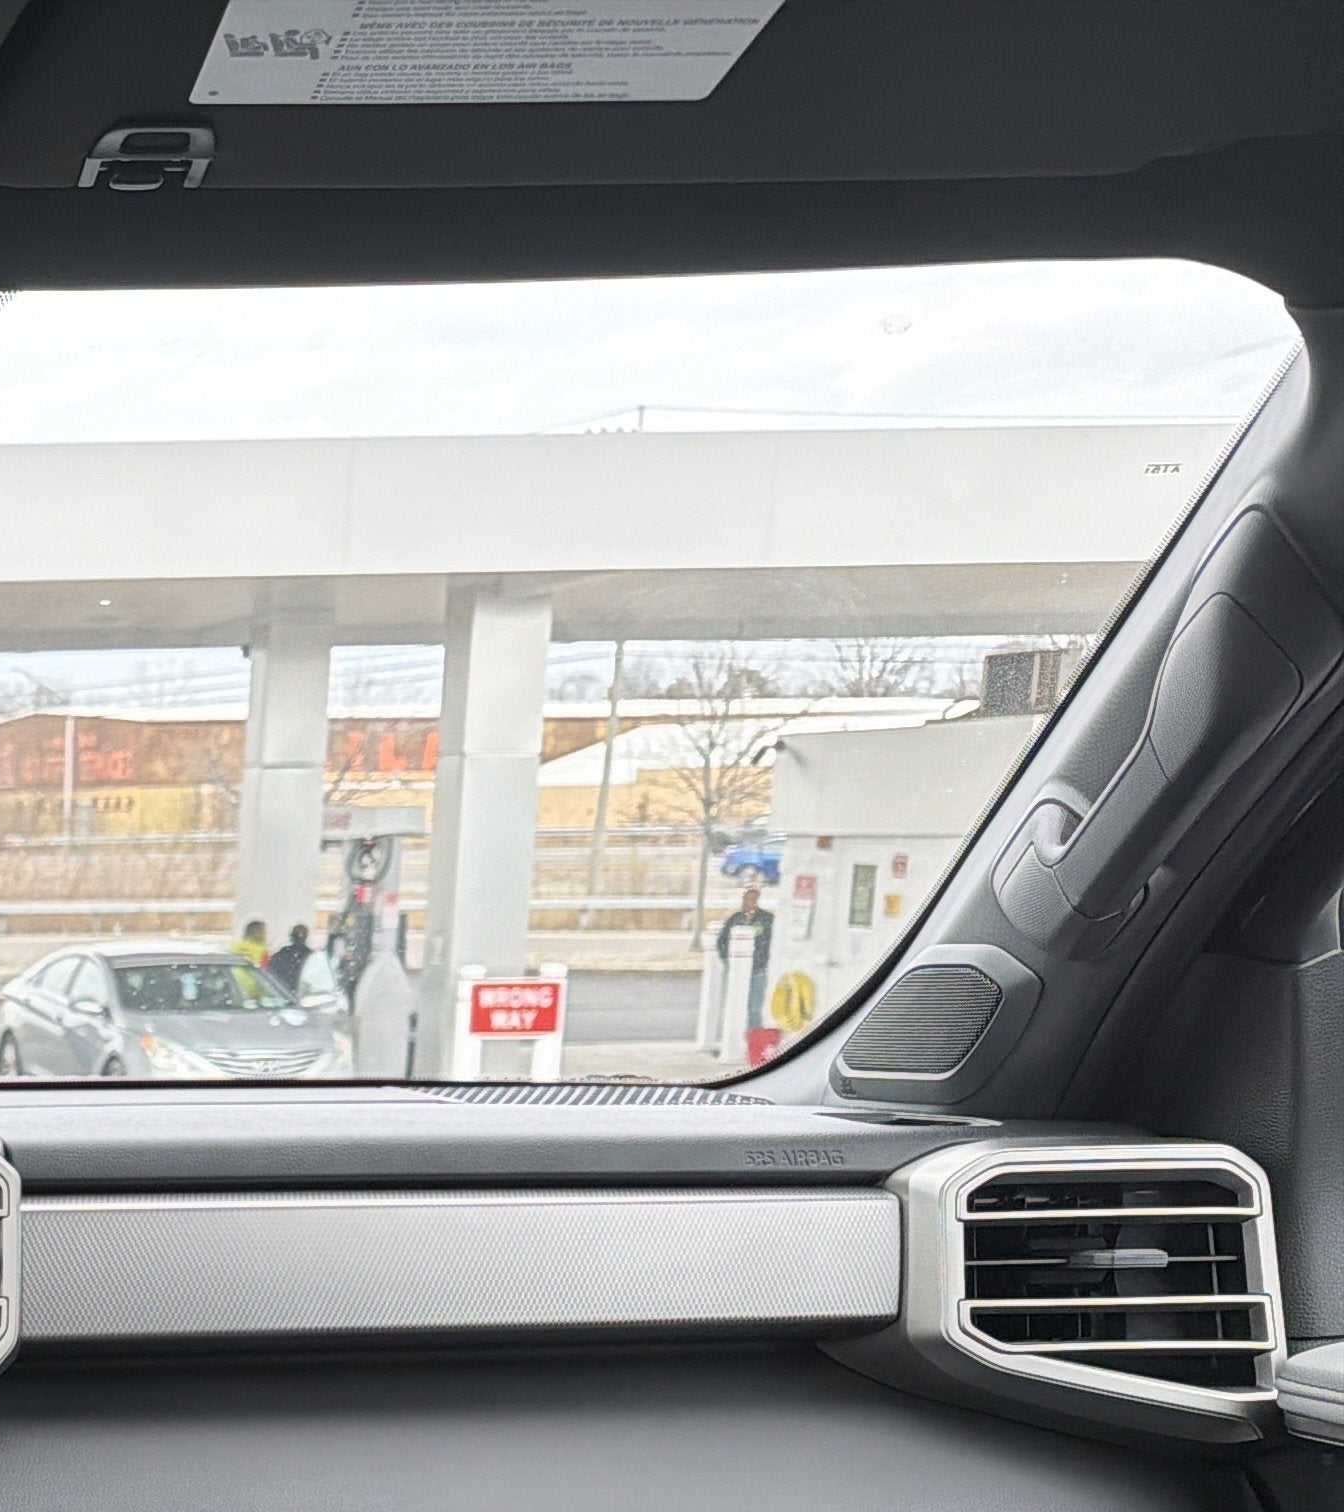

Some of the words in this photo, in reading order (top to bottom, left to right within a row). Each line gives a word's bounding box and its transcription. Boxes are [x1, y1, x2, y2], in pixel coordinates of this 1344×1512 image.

[479, 986, 555, 1009] WRONG
[489, 1008, 540, 1031] WAY
[745, 1150, 775, 1166] SRS
[781, 1149, 844, 1167] AIRBAG
